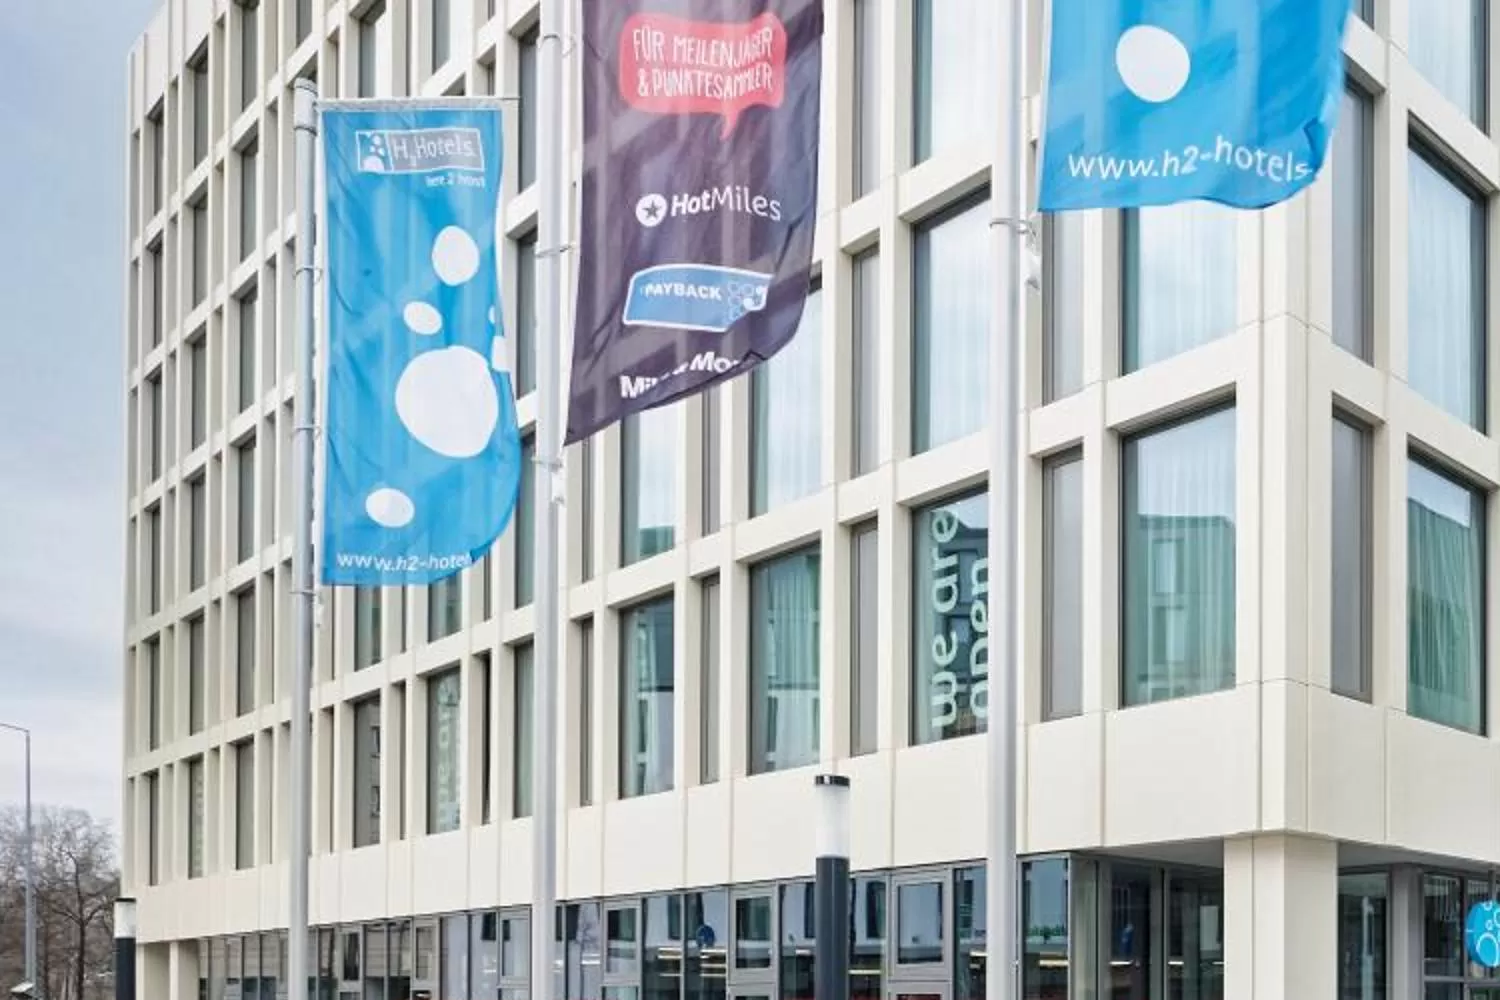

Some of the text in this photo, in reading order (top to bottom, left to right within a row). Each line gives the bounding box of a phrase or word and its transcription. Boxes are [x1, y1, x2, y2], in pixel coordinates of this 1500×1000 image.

[632, 24, 665, 62] FÜR
[669, 184, 782, 221] HotMiles
[644, 282, 723, 300] PAYBACK
[931, 509, 959, 729] we are
